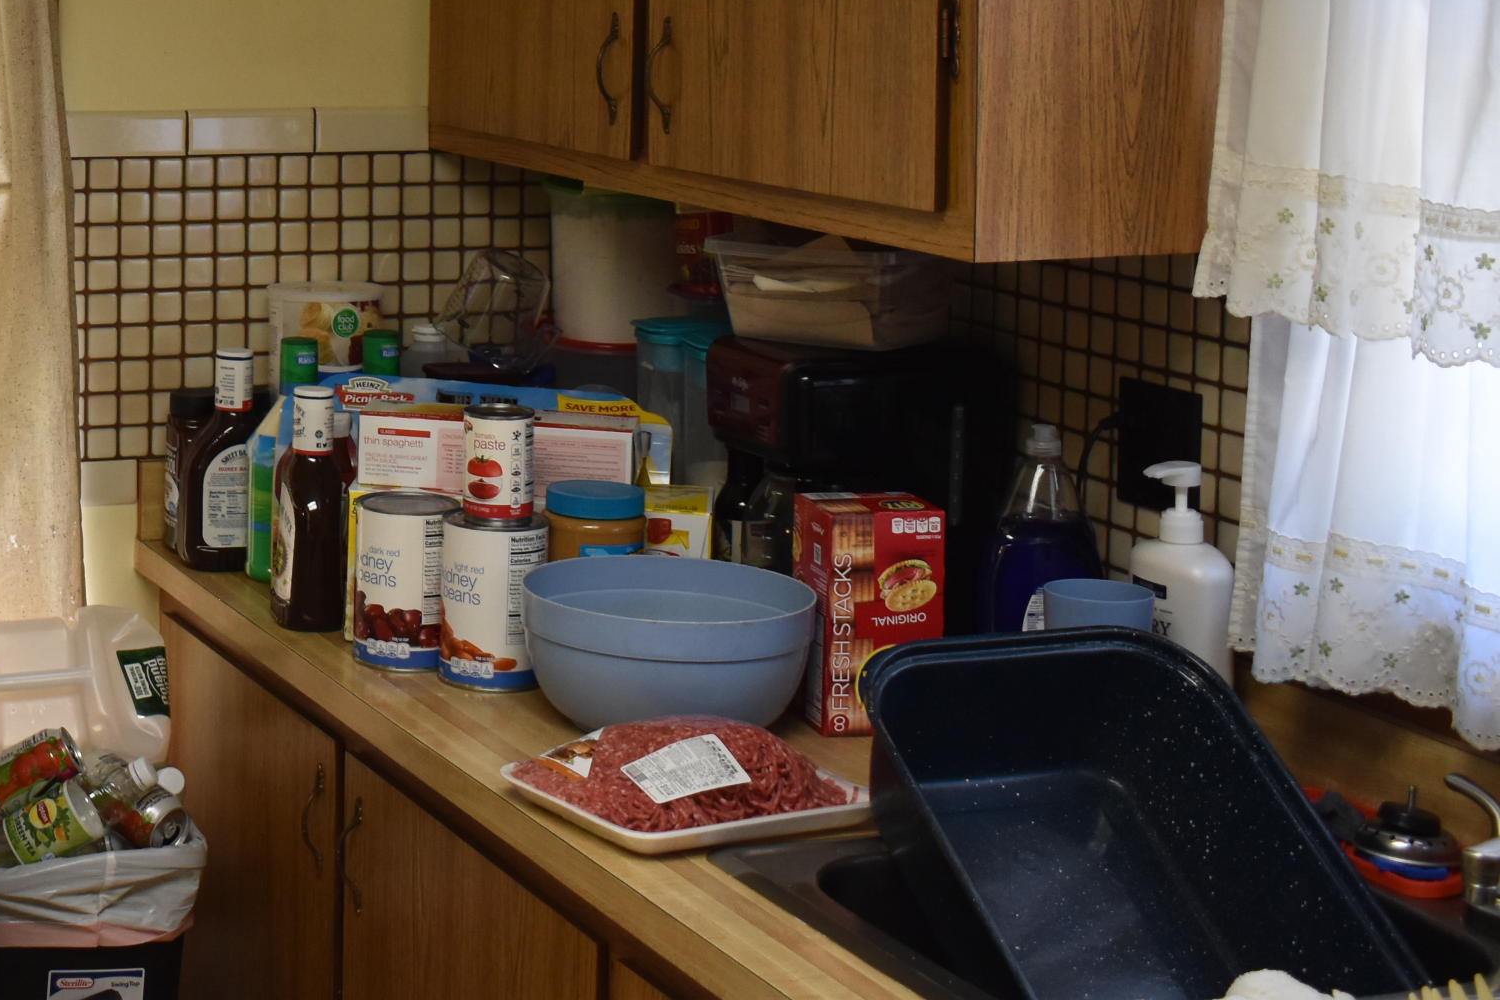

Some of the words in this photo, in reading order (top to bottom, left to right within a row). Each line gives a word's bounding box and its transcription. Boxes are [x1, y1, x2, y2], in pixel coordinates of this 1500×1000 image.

[337, 314, 355, 323] food
[337, 322, 355, 331] club
[355, 381, 381, 390] HEINZ
[564, 402, 596, 413] SAVE
[597, 404, 637, 414] MORE
[364, 436, 380, 445] thin
[382, 438, 424, 449] spaghetti
[473, 439, 507, 453] paste
[510, 536, 536, 544] Nutrition
[370, 546, 384, 556] dark
[386, 549, 400, 558] red
[360, 552, 394, 574] dney
[454, 562, 469, 574] light
[470, 565, 485, 575] red
[832, 553, 853, 637] STACKS
[870, 611, 927, 627] ORIGINAL
[831, 640, 852, 712] FRESH
